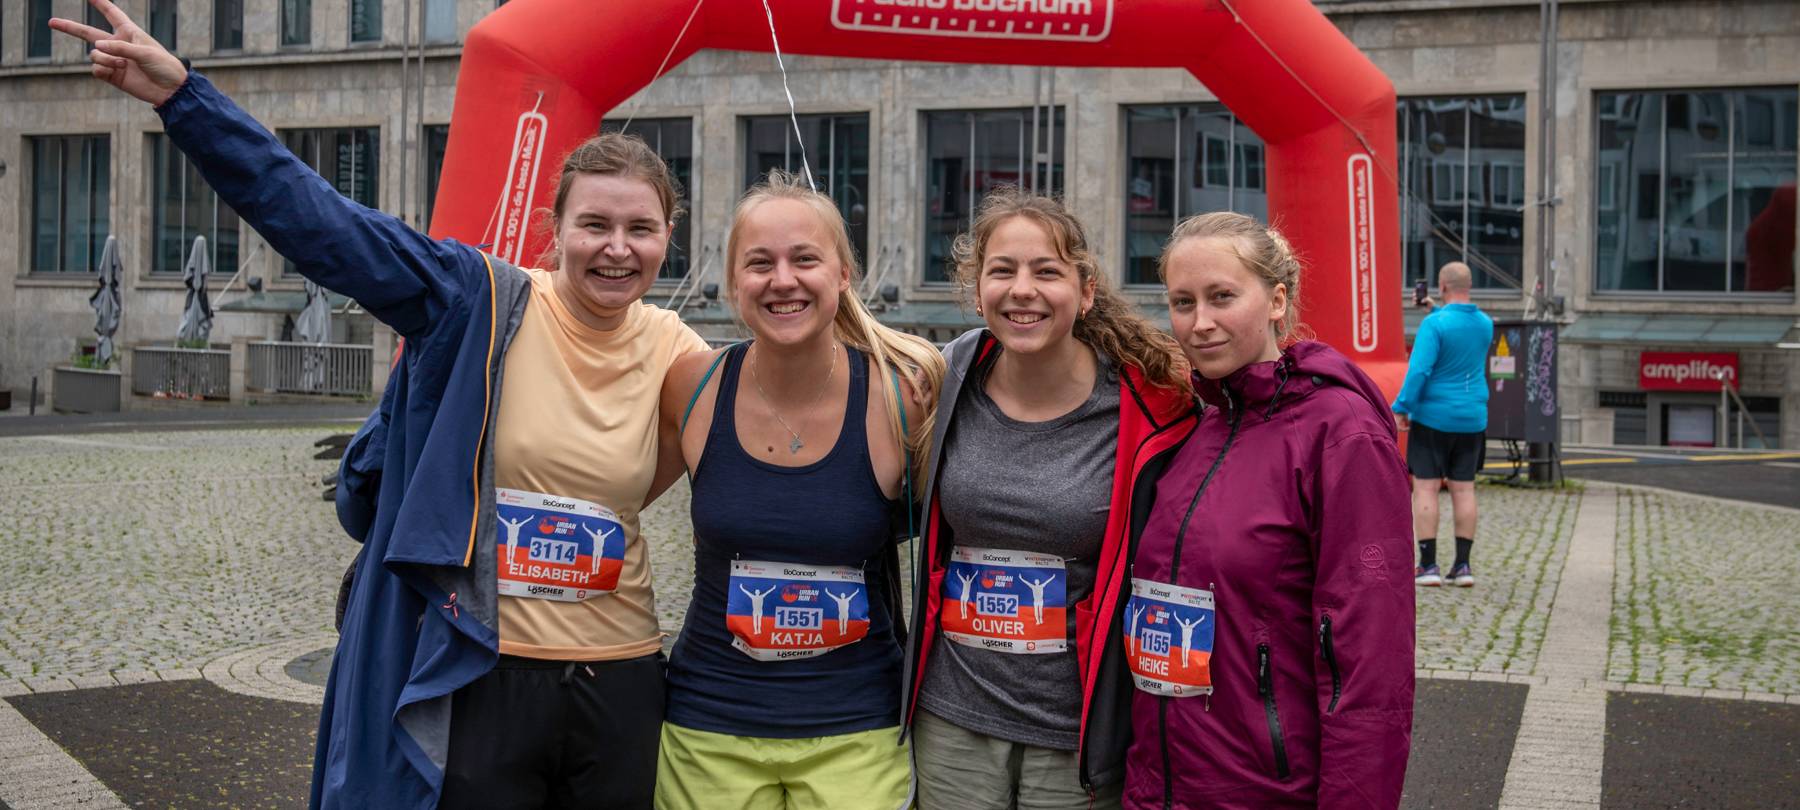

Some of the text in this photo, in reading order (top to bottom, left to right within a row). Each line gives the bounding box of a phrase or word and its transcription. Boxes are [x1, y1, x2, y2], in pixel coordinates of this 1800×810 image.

[515, 160, 530, 189] beste
[513, 190, 524, 207] die
[1357, 198, 1368, 226] beste
[506, 207, 521, 238] 100%
[1358, 226, 1368, 241] die
[1359, 241, 1369, 271] 100%
[1362, 293, 1370, 310] von
[1360, 310, 1371, 341] 100%
[1642, 360, 1735, 384] amplifon
[542, 499, 577, 511] BoConcept
[556, 521, 577, 530] URBAN
[530, 541, 576, 562] 3114
[982, 553, 1012, 564] BoConcept
[508, 563, 590, 584] ELISABETH
[783, 569, 817, 578] BoConcept
[527, 585, 564, 596] LÖSCHER
[799, 589, 820, 597] URBAN
[977, 596, 1018, 615] 1552
[776, 609, 820, 627] 1551
[972, 618, 1025, 636] OLIVER
[770, 632, 825, 646] KATJA
[982, 639, 1014, 649] LÖSCHER
[1142, 631, 1170, 654] 1155
[776, 650, 814, 659] LÖSCHER
[1138, 655, 1170, 677] HEIKE
